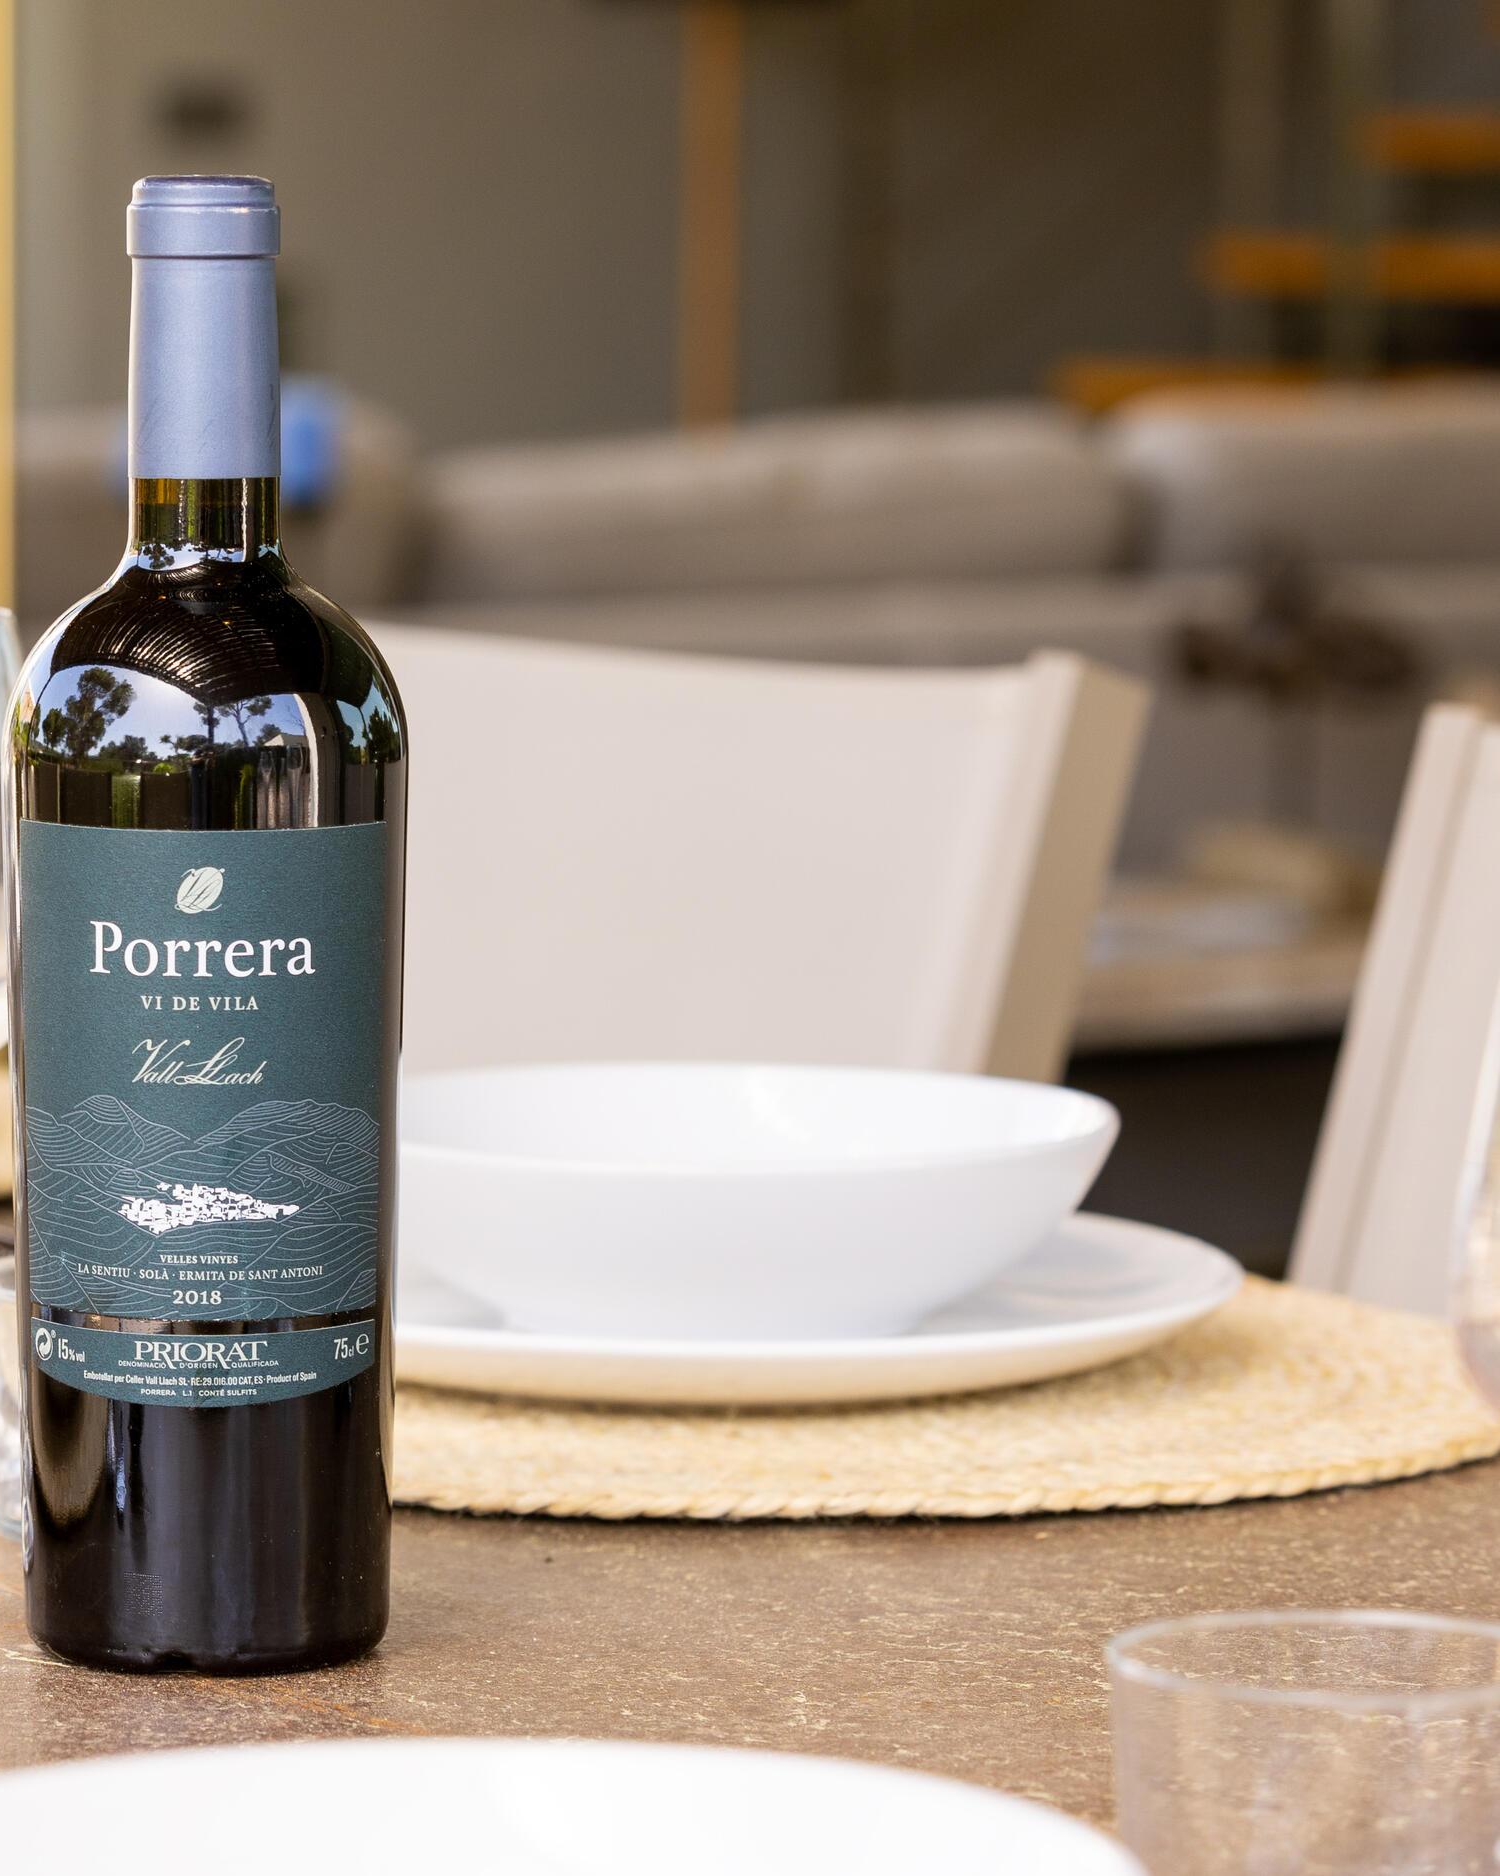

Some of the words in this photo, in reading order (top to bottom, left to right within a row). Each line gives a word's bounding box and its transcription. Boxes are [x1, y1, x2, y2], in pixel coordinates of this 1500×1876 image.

[90, 920, 315, 978] Porrera
[141, 996, 162, 1010] VI
[173, 997, 199, 1011] DE
[209, 996, 259, 1011] VILA
[132, 1039, 190, 1083] Vall
[159, 1255, 197, 1264] VELLES
[200, 1255, 238, 1264] VINYES
[78, 1263, 89, 1274] LA
[92, 1265, 130, 1278] SENTIU
[140, 1269, 169, 1280] SOLÀ
[179, 1271, 225, 1280] ERMITA
[229, 1271, 245, 1280] DE
[248, 1270, 278, 1280] SANT
[281, 1266, 323, 1278] ANTONI
[173, 1290, 222, 1305] 2018
[134, 1341, 268, 1369] PRIORAT
[118, 1360, 166, 1369] DENOMINACIÓ
[232, 1360, 279, 1368] QUALIFICADA
[84, 1370, 113, 1382] Embotellat
[114, 1375, 125, 1384] per
[125, 1375, 144, 1384] Celler
[145, 1376, 158, 1385] Vall
[159, 1376, 177, 1385] Llach
[267, 1374, 291, 1383] Product
[293, 1373, 299, 1381] of
[300, 1371, 317, 1382] Spain
